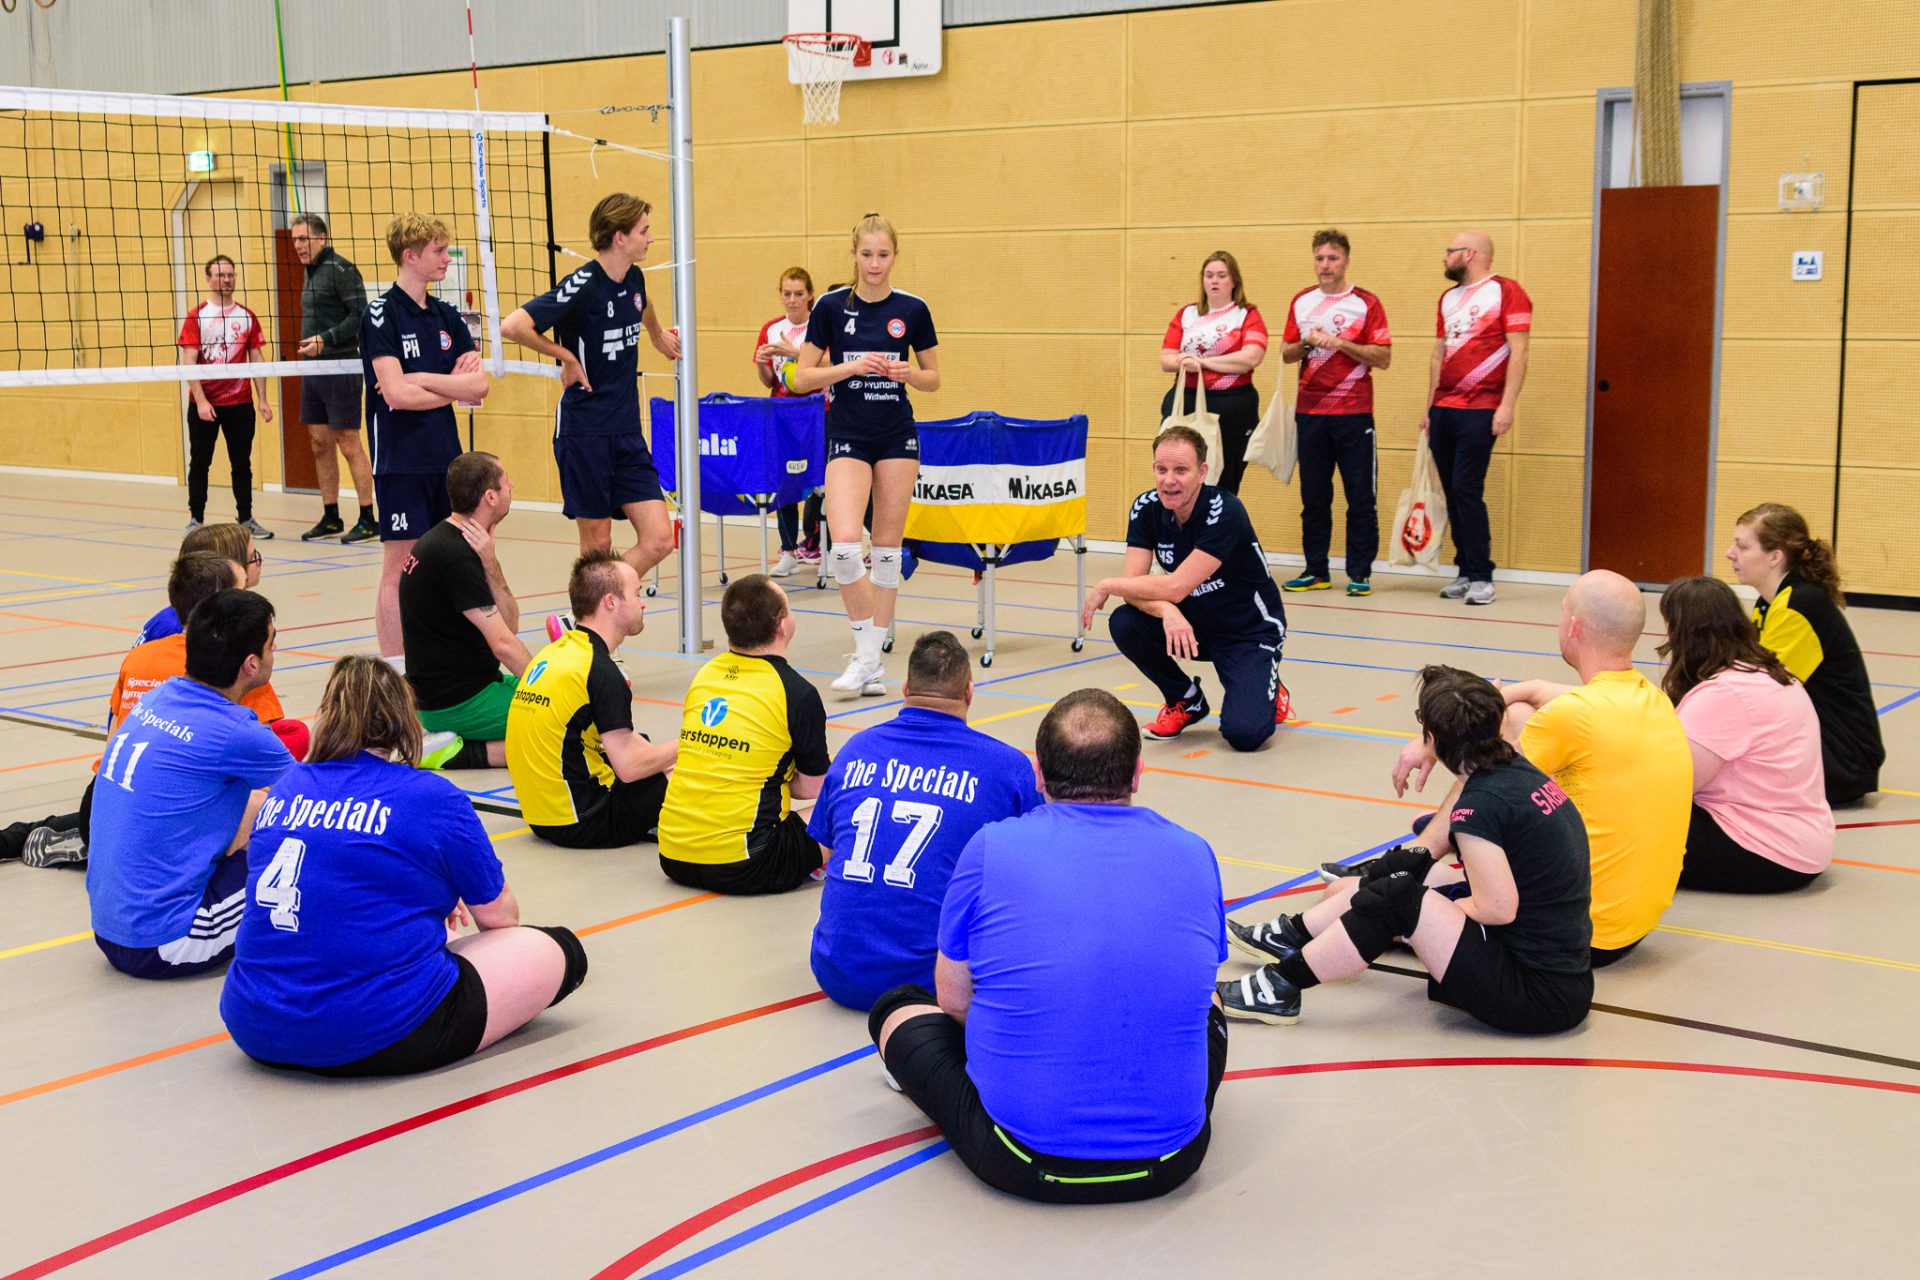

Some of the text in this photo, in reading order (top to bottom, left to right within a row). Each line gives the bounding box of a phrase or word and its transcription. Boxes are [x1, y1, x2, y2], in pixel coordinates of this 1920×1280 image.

[479, 179, 487, 208] Sports
[606, 301, 614, 318] 8
[844, 318, 856, 336] 4
[402, 339, 420, 359] PH
[697, 432, 737, 456] ala
[913, 475, 974, 500] IKASA
[391, 512, 408, 531] 24
[1189, 578, 1226, 598] ALENTS
[140, 708, 195, 744] Specials
[680, 728, 751, 753] erstappen
[102, 732, 149, 792] 11
[842, 757, 979, 804] The Specials
[283, 793, 393, 837] Specials
[842, 796, 944, 889] 17
[255, 837, 307, 932] 4
